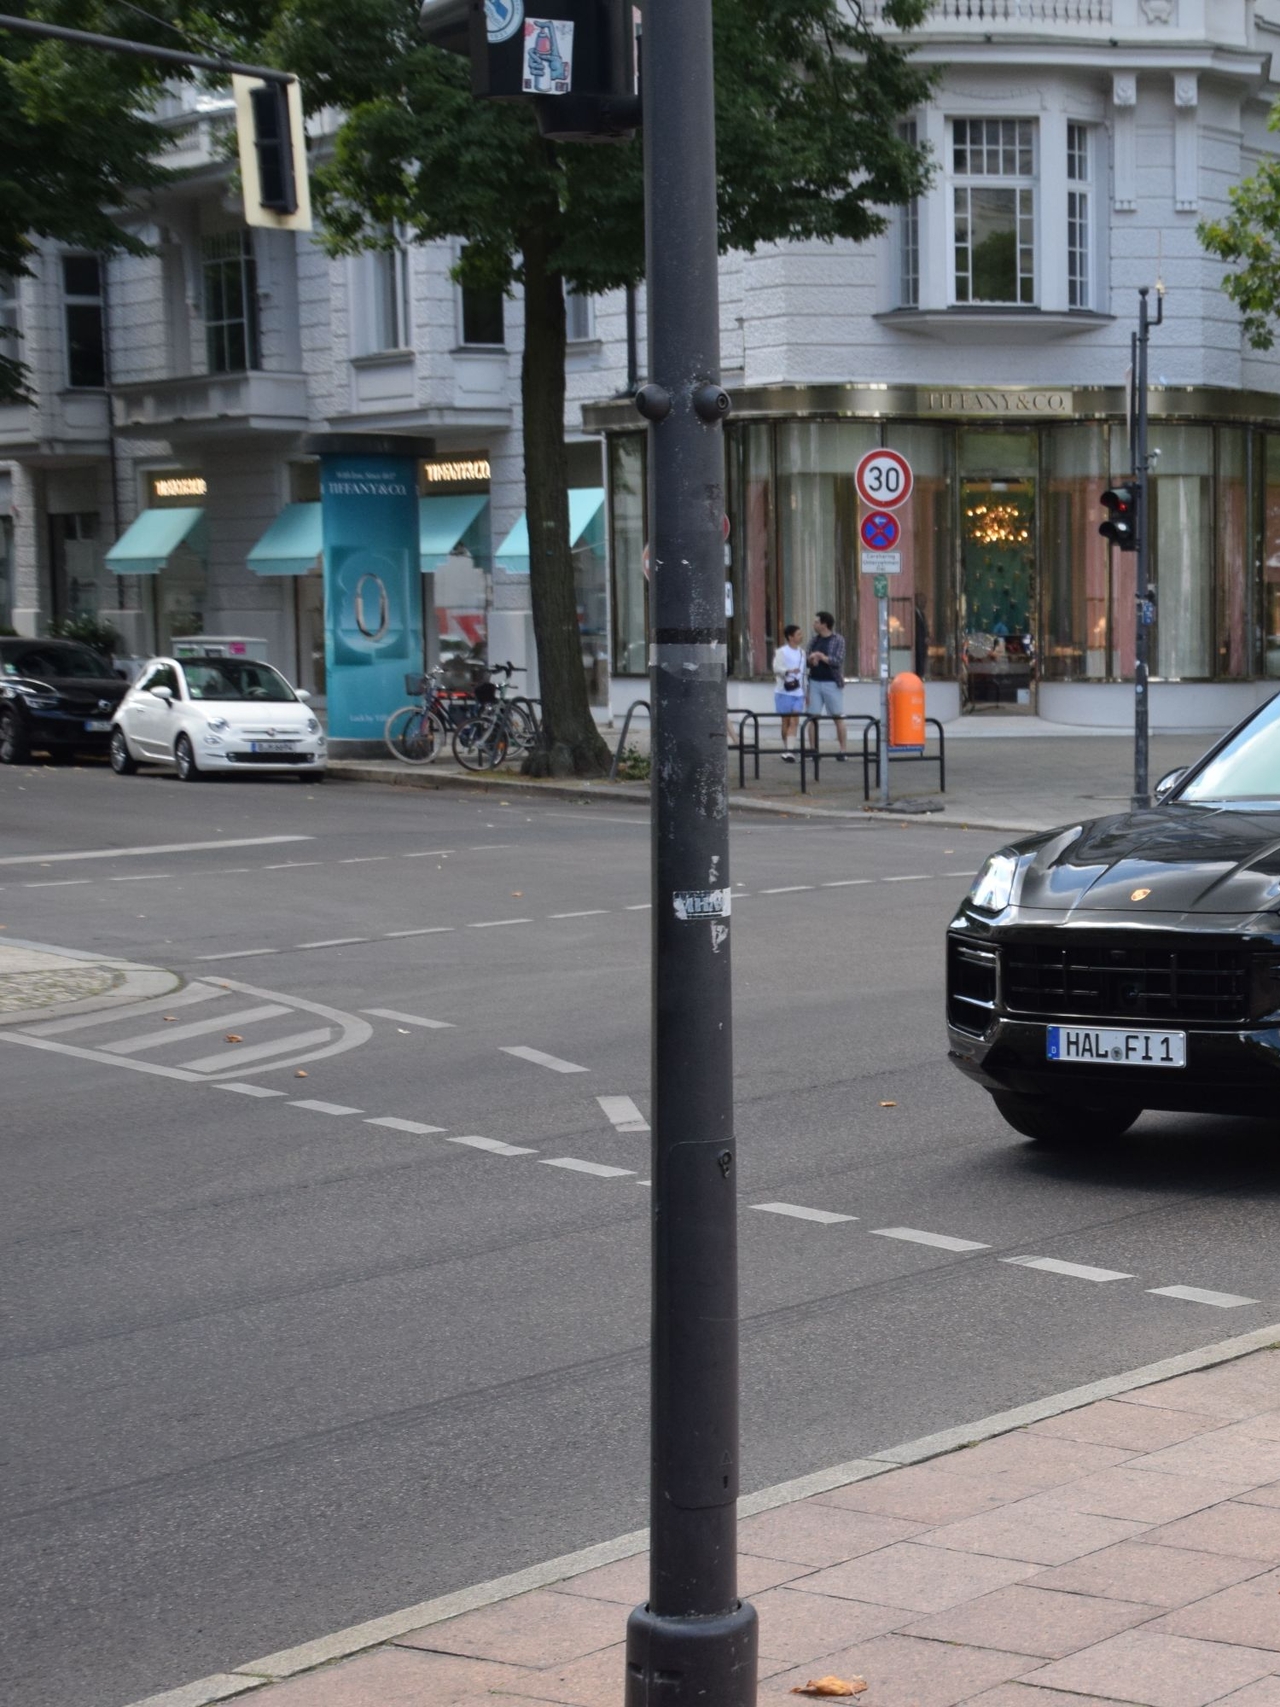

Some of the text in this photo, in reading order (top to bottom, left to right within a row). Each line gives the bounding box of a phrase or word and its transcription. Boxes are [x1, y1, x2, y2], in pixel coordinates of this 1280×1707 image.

[928, 392, 1066, 411] TIFFANY&CO.
[868, 466, 900, 493] 30
[1066, 1031, 1109, 1059] HAL
